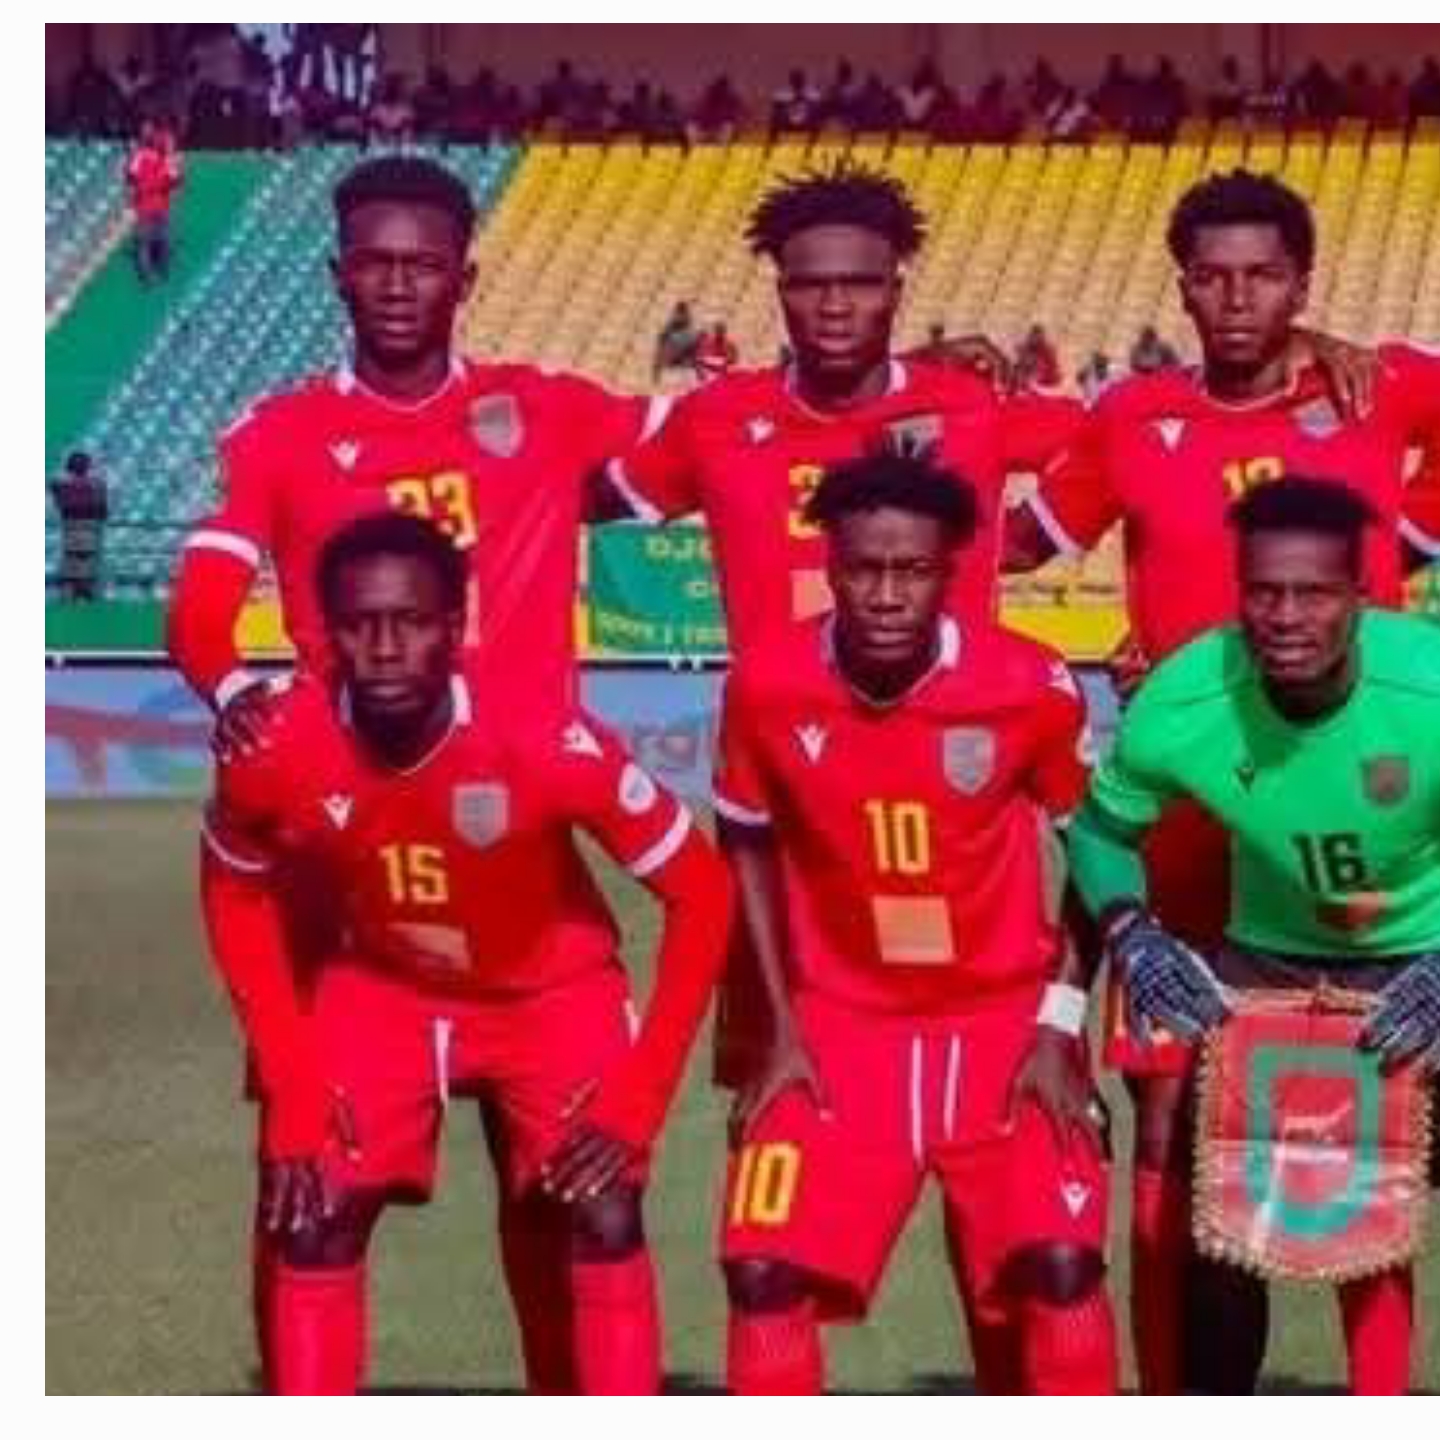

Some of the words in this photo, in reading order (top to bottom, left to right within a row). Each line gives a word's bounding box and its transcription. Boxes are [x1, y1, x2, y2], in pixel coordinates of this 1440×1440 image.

[788, 464, 826, 539] 2
[378, 843, 449, 904] 15
[865, 799, 931, 874] 10
[1291, 833, 1368, 893] 16
[731, 1140, 800, 1226] 10
